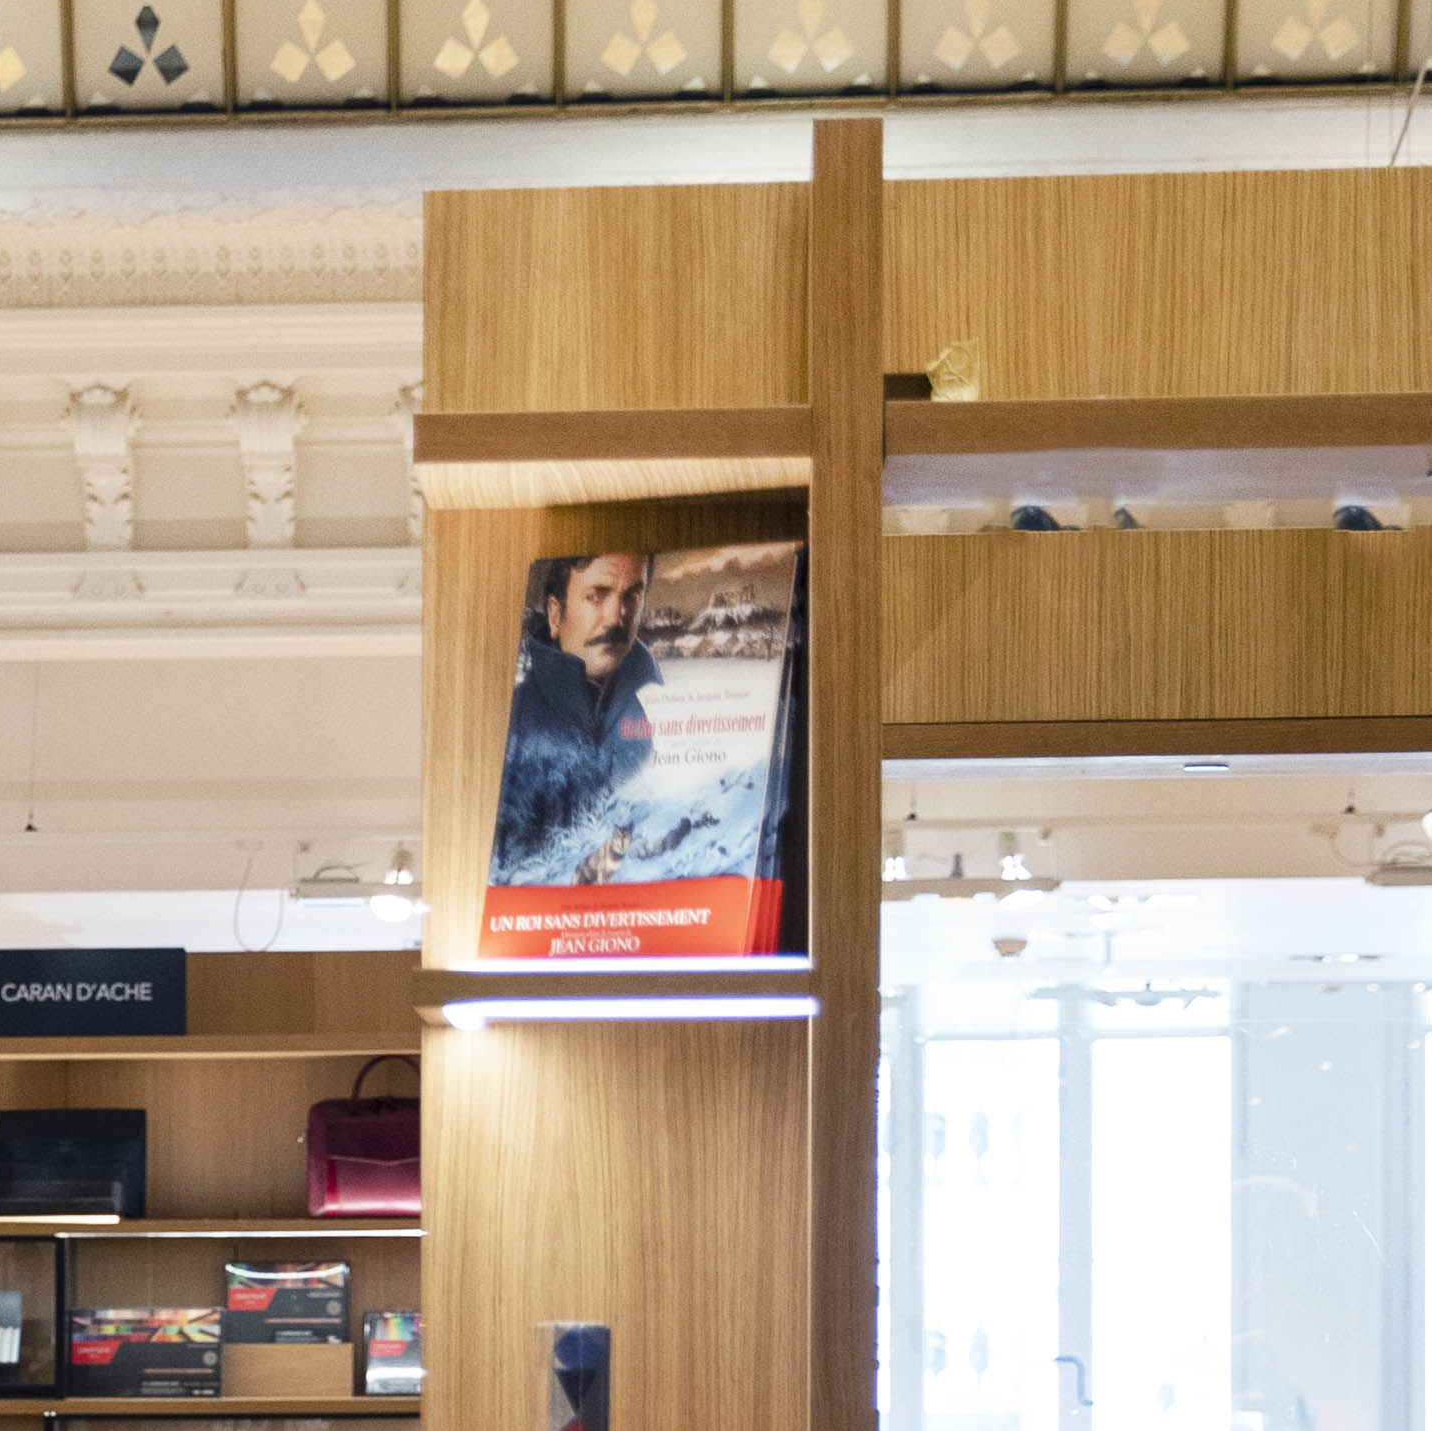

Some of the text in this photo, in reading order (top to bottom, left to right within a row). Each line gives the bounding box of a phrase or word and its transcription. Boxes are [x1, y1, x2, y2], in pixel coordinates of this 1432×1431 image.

[658, 718, 684, 737] sans
[685, 712, 766, 735] divertissement
[489, 915, 514, 932] UN
[515, 913, 543, 930] ROI
[544, 912, 580, 929] SANS
[583, 907, 712, 928] DIVERTISSEMENT
[549, 935, 641, 957] JEAN GIONO
[0, 981, 153, 1002] CARAN D'ACHE
